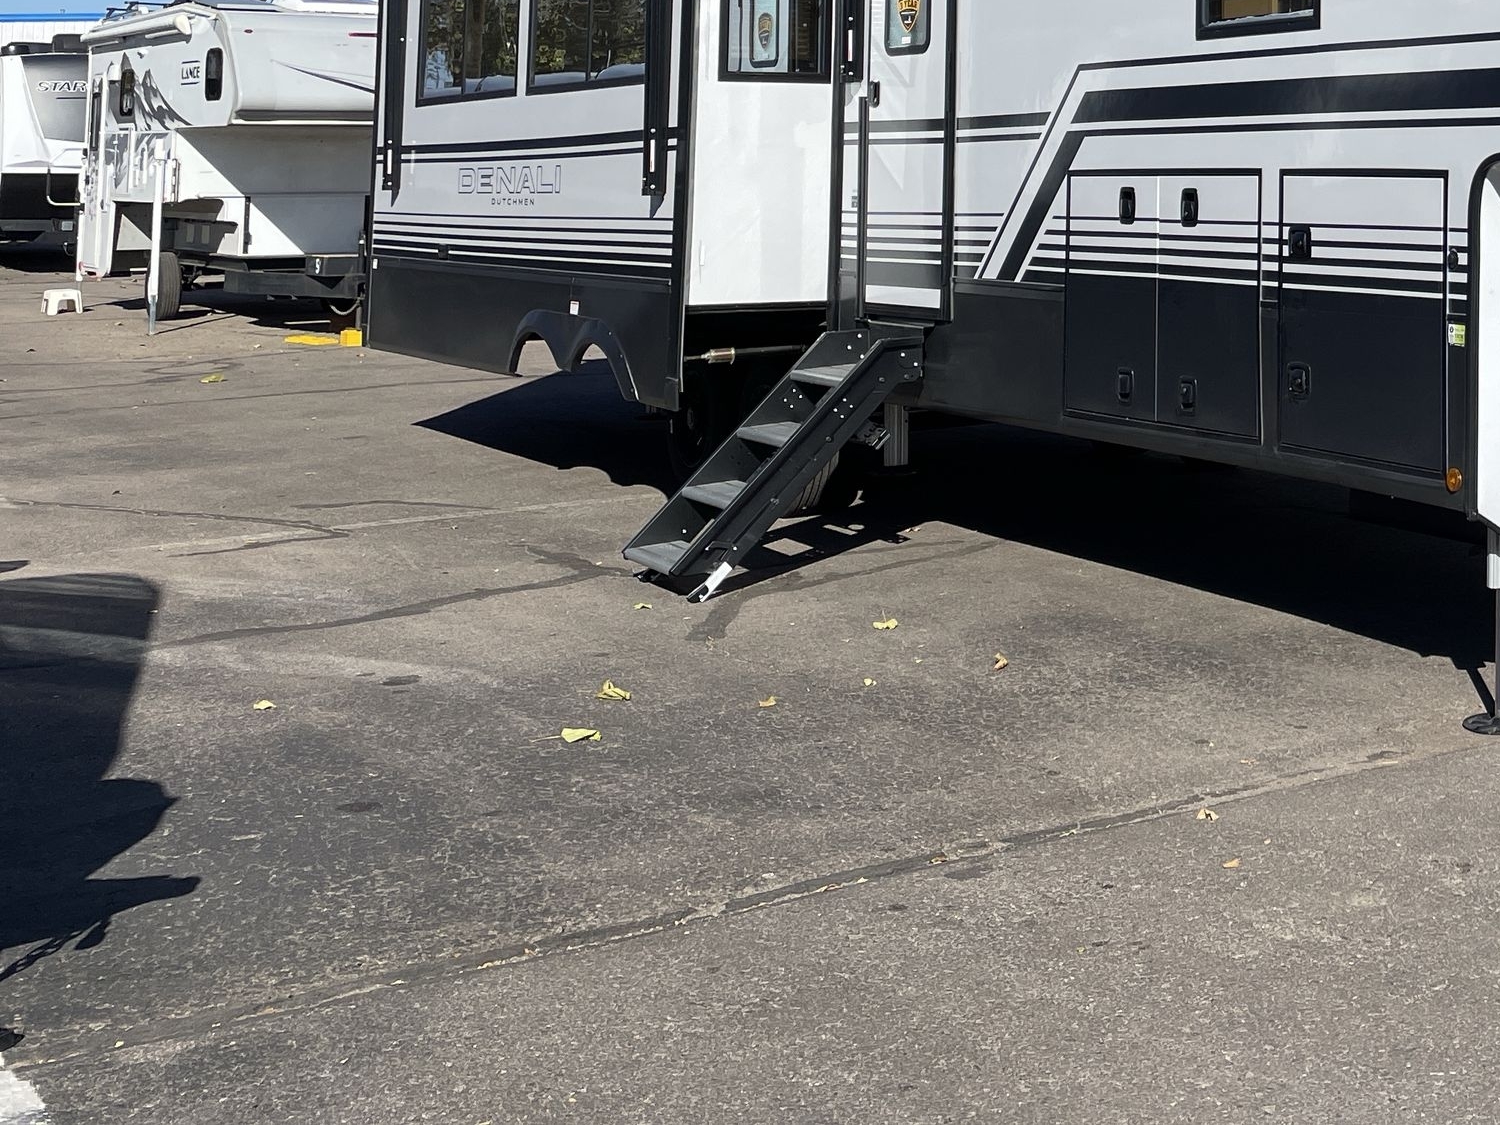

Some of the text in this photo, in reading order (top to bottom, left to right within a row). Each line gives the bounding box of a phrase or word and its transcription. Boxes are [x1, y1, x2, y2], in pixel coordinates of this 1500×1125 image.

[181, 66, 201, 80] LANCE
[458, 165, 561, 194] DENALI
[491, 197, 535, 206] DUTCHMEN
